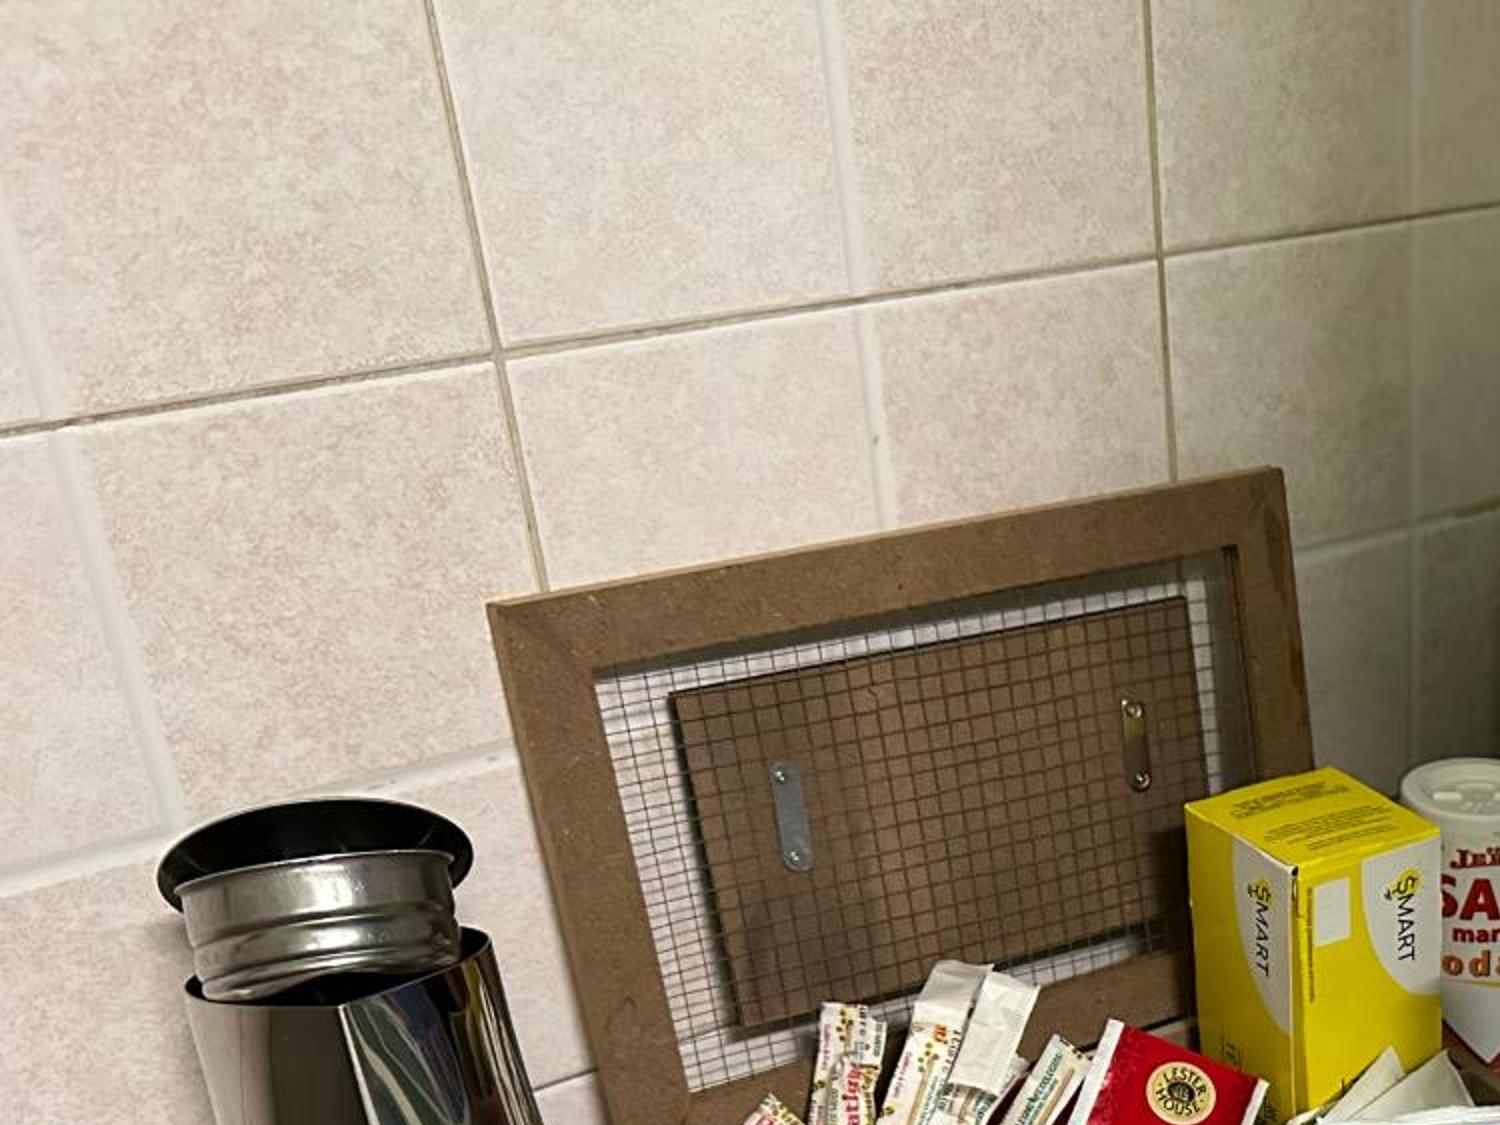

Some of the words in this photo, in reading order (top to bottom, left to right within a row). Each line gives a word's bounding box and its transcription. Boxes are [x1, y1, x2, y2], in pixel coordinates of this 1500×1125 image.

[1253, 881, 1273, 978] SMART
[1396, 871, 1420, 963] SMART
[1156, 1088, 1201, 1117] HOUSE
[1163, 1067, 1207, 1098] LESTER
